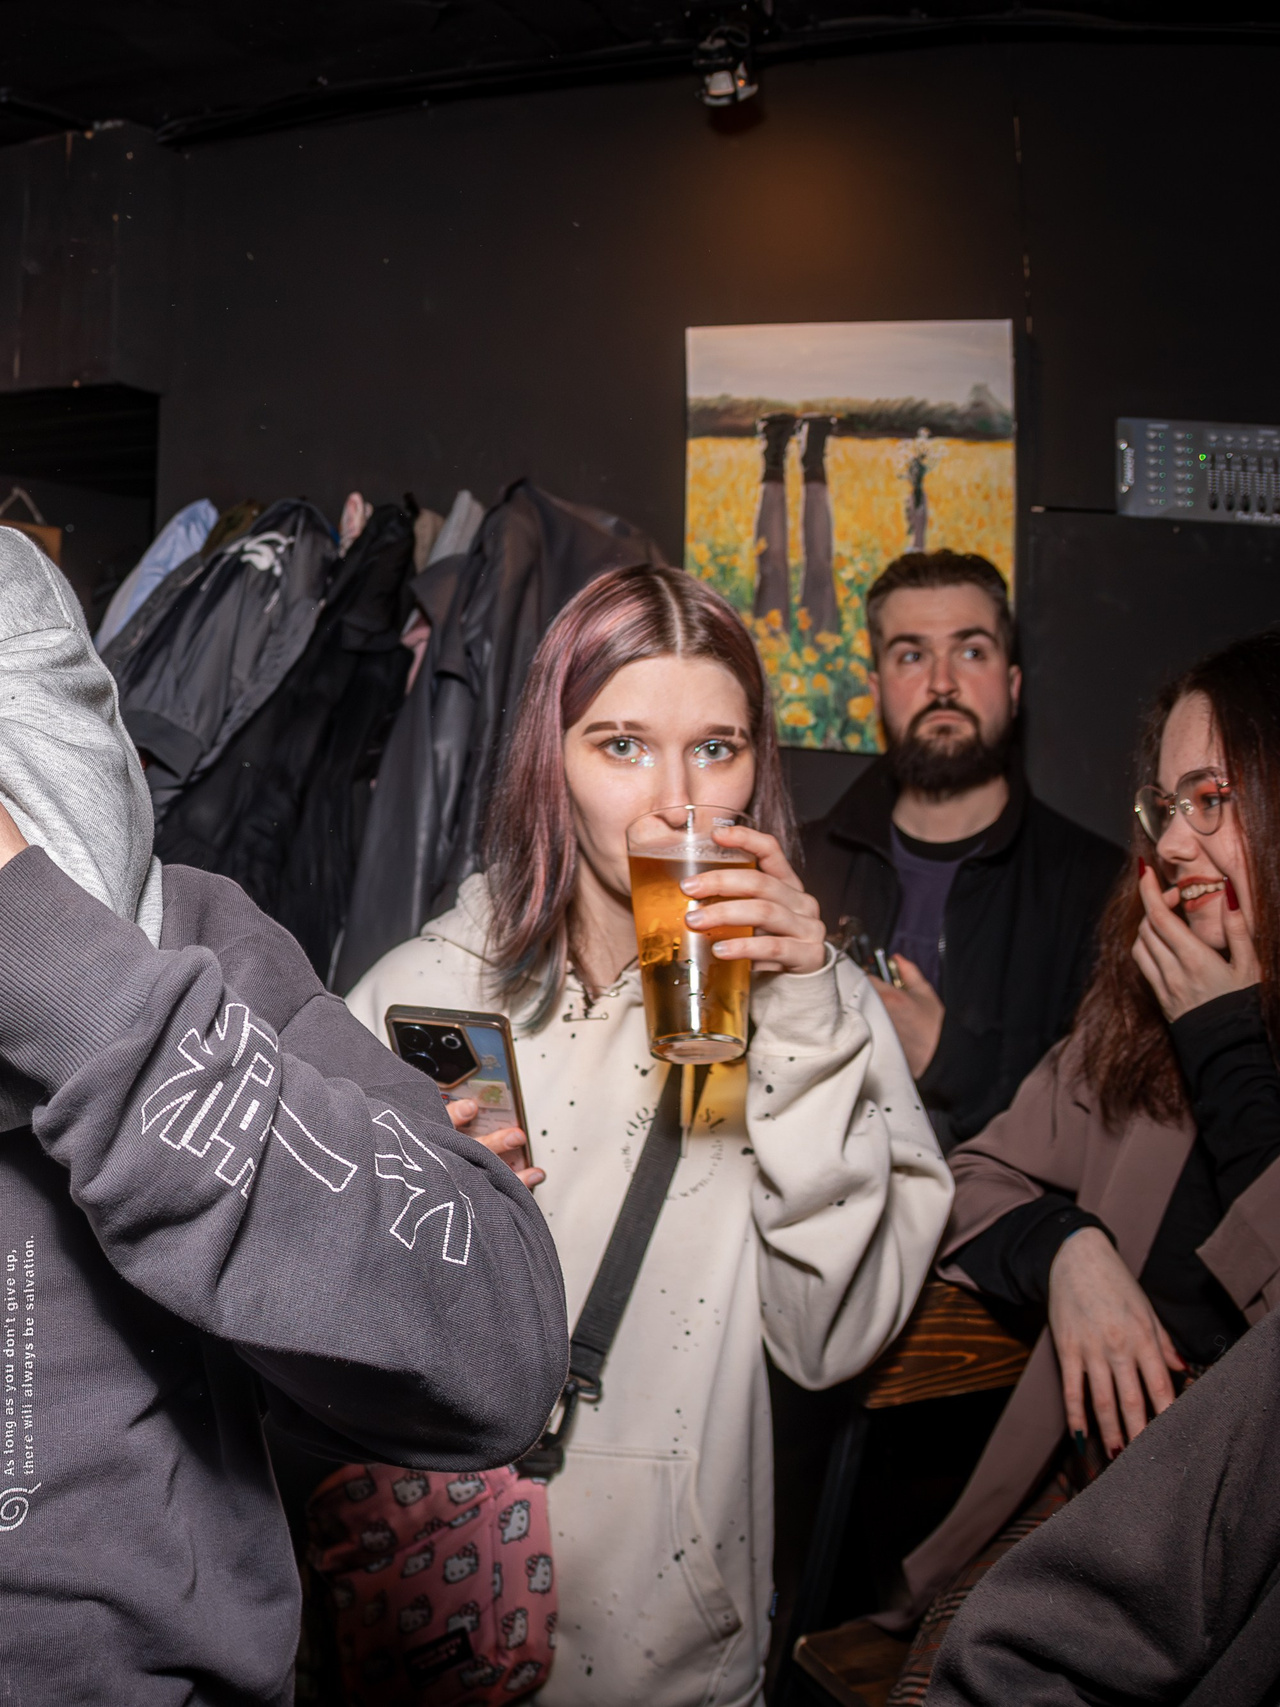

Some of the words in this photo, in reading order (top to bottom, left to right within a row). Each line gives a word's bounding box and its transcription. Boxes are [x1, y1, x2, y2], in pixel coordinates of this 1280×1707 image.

[6, 1249, 18, 1272] up,
[23, 1235, 35, 1311] salvation.
[4, 1277, 18, 1312] give
[3, 1317, 15, 1358] don't
[22, 1317, 34, 1337] be
[4, 1364, 17, 1393] you
[21, 1342, 36, 1398] always
[5, 1398, 15, 1416] as
[21, 1404, 33, 1430] will
[3, 1420, 17, 1455] long
[4, 1459, 15, 1477] As
[23, 1434, 34, 1476] there
